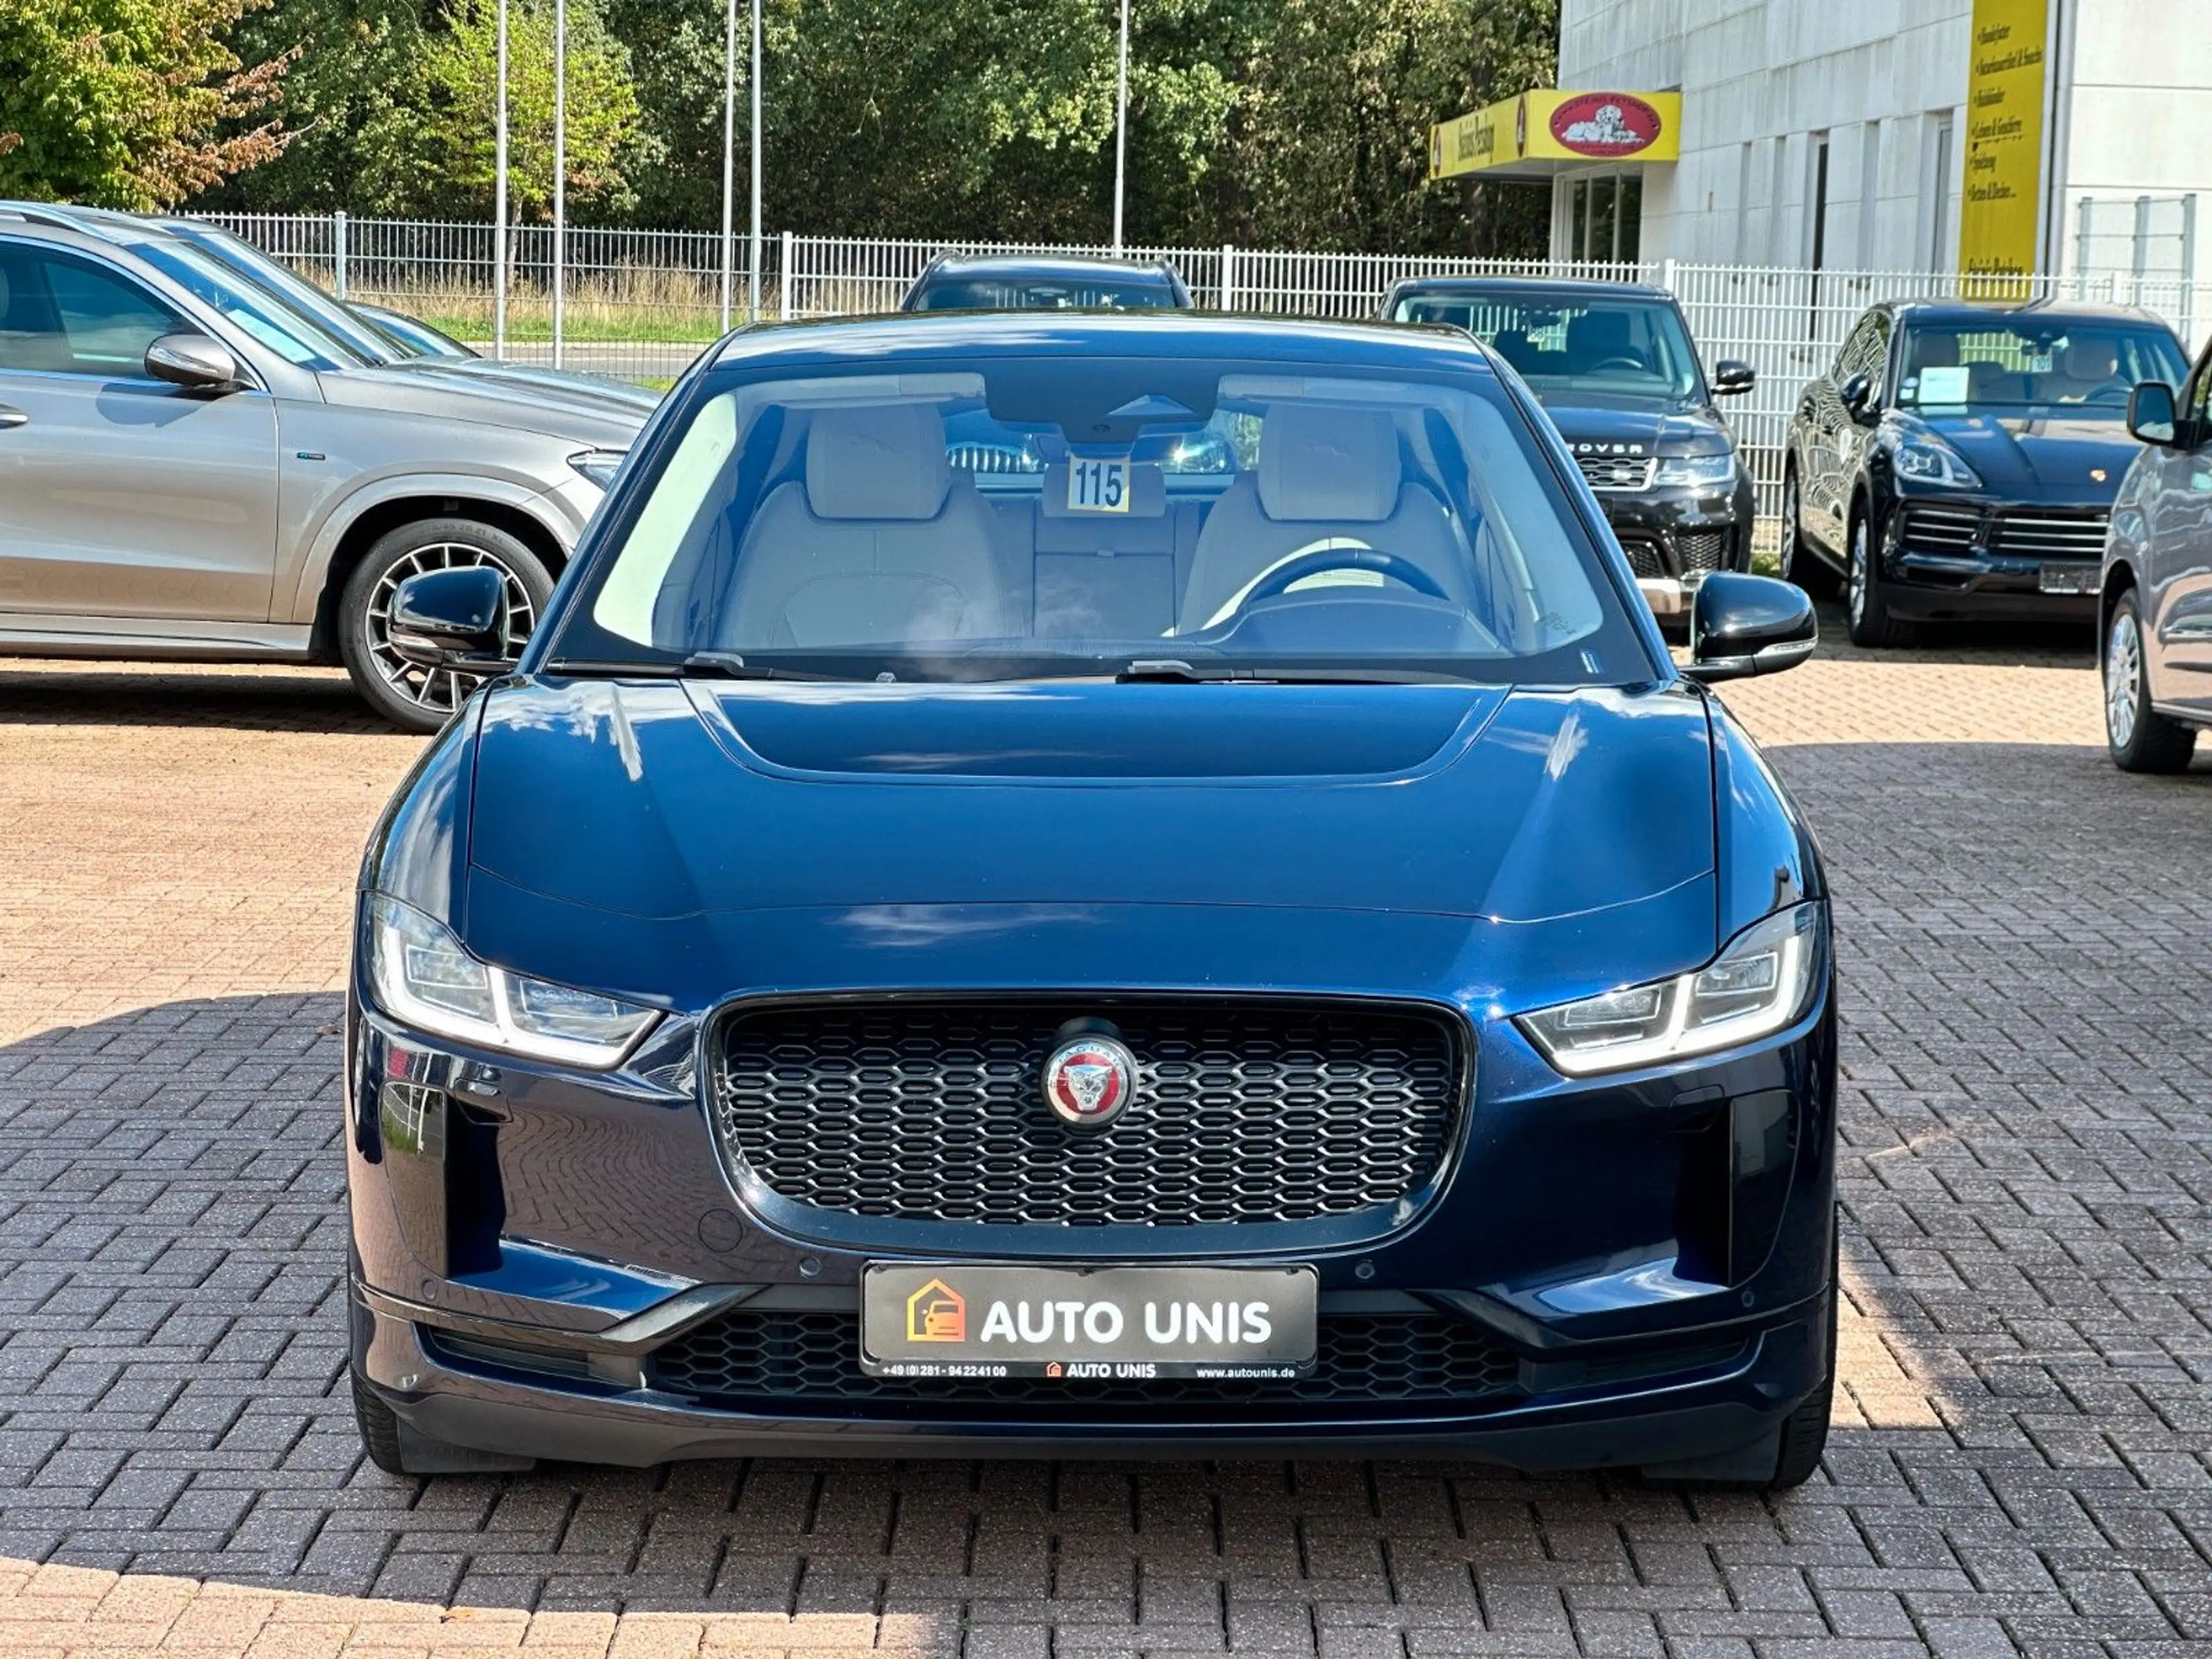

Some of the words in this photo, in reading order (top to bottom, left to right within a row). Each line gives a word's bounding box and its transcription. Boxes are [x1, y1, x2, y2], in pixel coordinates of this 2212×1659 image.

[1075, 461, 1122, 507] 115
[979, 1300, 1124, 1343] AUTO
[1144, 1301, 1272, 1344] UNIS
[1066, 1363, 1111, 1378] AUTO
[1115, 1363, 1157, 1378] UNIS
[1196, 1366, 1296, 1378] www.autounis.de
